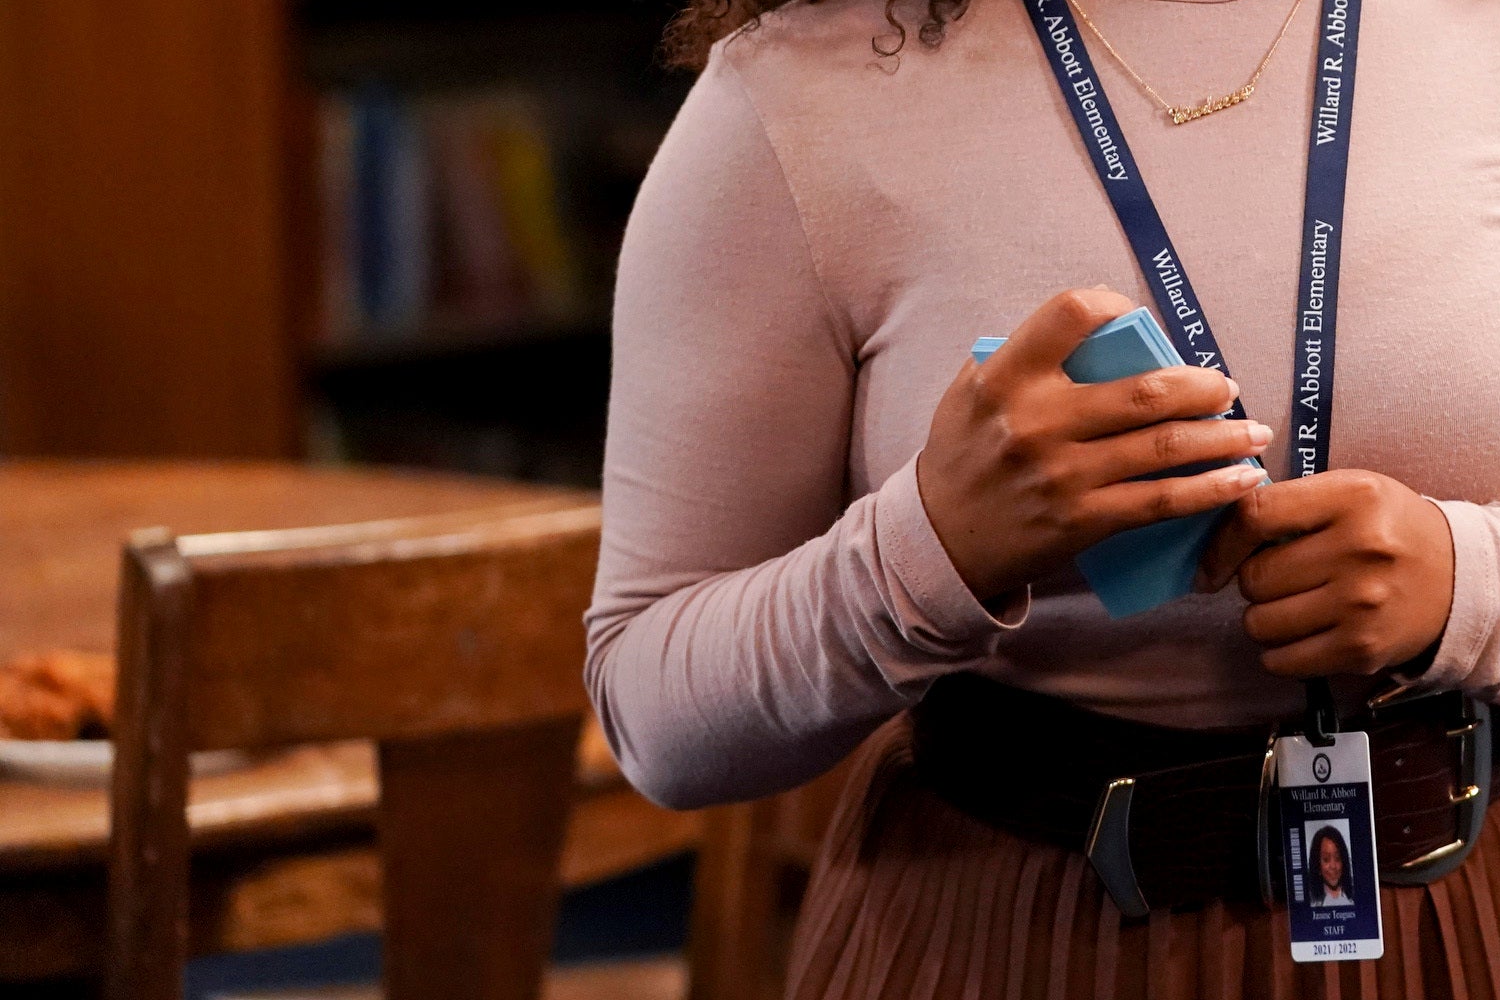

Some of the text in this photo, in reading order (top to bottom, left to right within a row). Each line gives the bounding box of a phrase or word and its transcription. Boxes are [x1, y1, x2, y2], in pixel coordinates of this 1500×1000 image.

[1323, 52, 1344, 73] R.
[1044, 15, 1082, 78] Abbott
[1072, 76, 1129, 181] Elementary
[1316, 74, 1342, 146] Willard
[1303, 219, 1334, 333] Elementary
[1152, 248, 1205, 346] Willard R.
[1300, 338, 1322, 412] Abbott
[1298, 416, 1318, 442] R.
[1291, 787, 1357, 800] Willard R. Abbott
[1303, 801, 1346, 814] Elementary
[1323, 925, 1345, 936] STAFF
[1313, 944, 1331, 956] 2021
[1338, 942, 1357, 954] 2022
